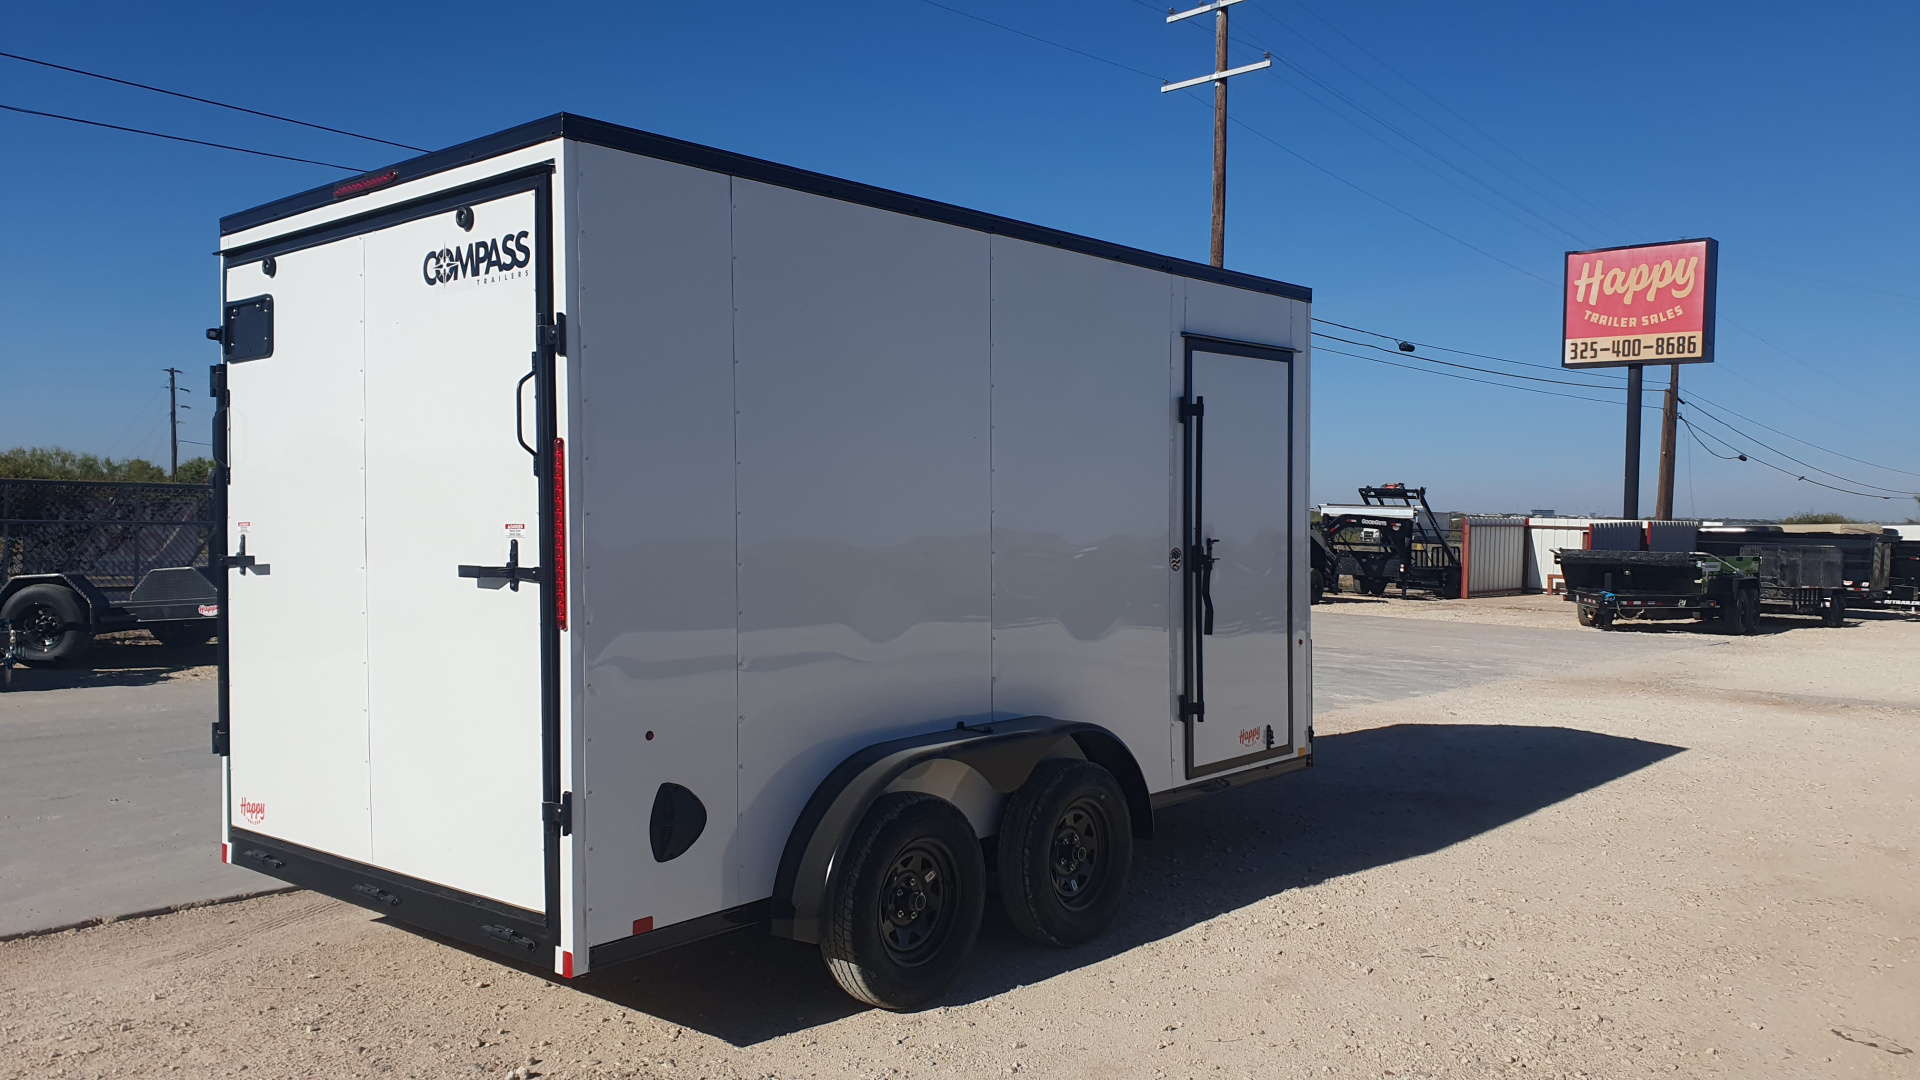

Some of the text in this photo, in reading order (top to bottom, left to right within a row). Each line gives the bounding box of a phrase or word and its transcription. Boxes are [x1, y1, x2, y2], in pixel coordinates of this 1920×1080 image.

[423, 230, 531, 287] COMPASS
[476, 269, 529, 286] TRAILERS
[1574, 256, 1698, 306] Happy
[1584, 305, 1683, 328] TRAILER SALES
[1570, 335, 1697, 360] 325-400-8686
[1239, 726, 1260, 745] Happy
[240, 796, 265, 820] Happy
